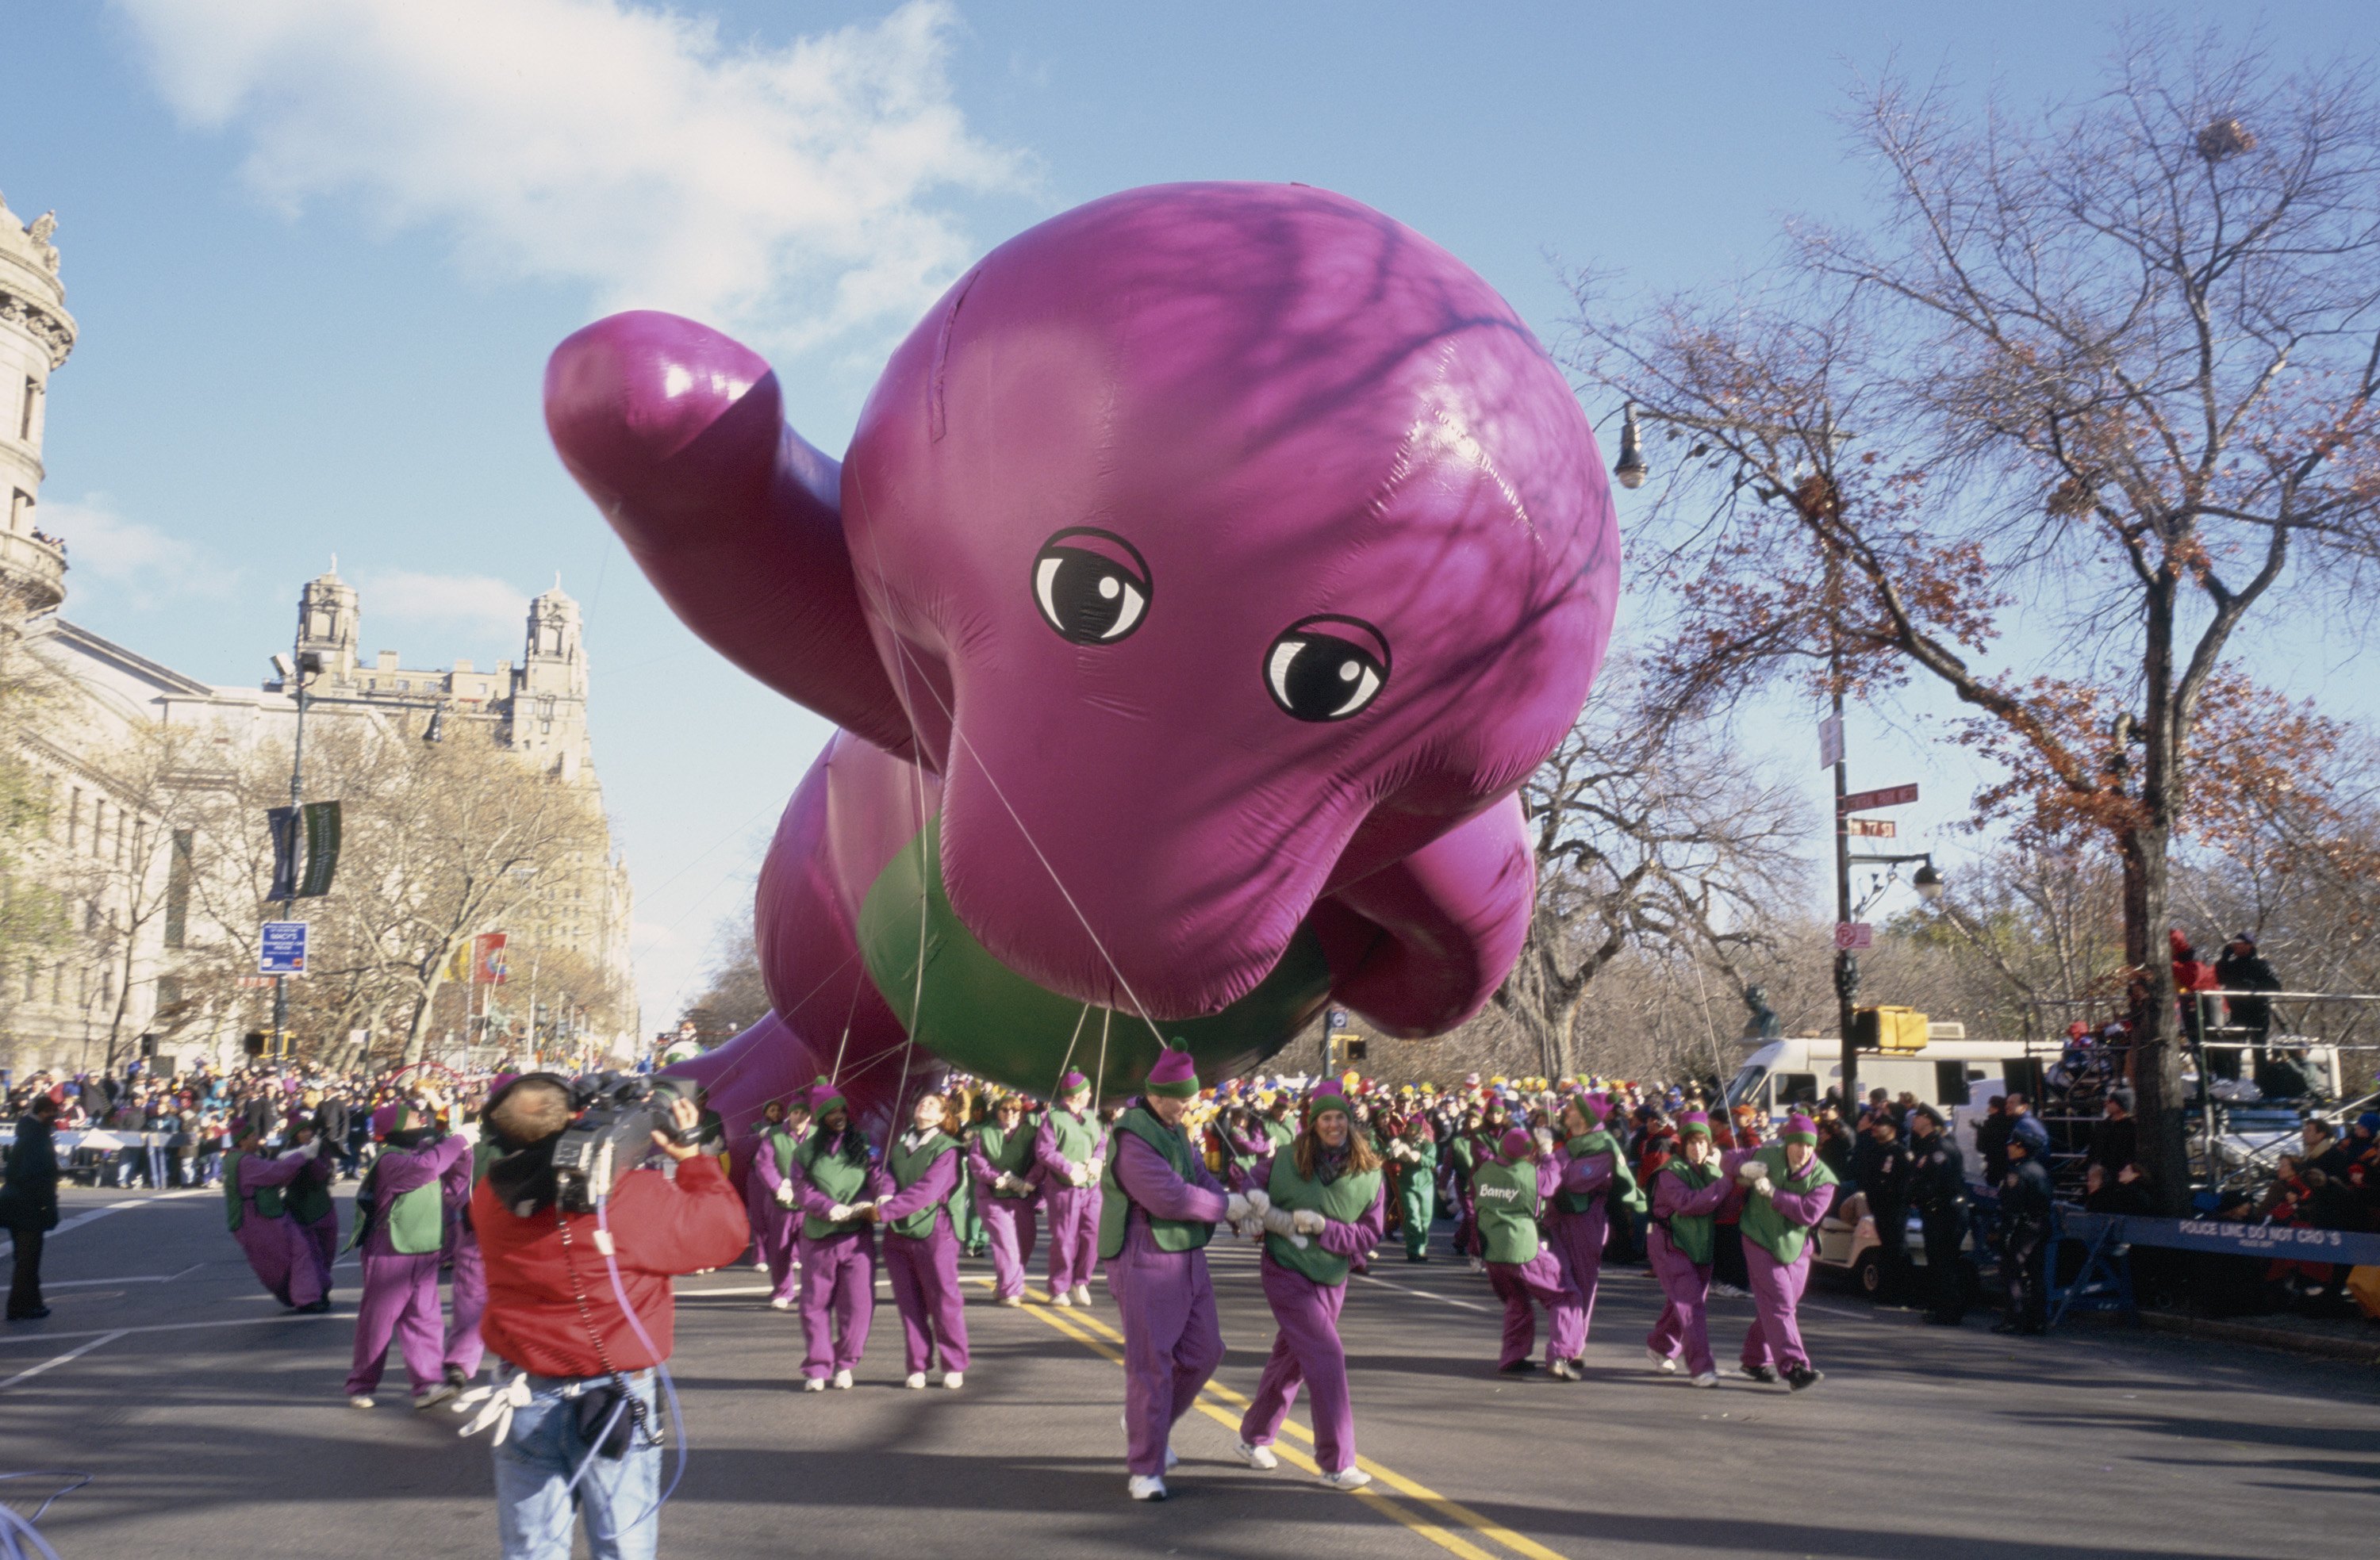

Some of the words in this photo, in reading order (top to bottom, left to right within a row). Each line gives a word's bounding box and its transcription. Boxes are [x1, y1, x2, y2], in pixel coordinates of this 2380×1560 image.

[1480, 1183, 1519, 1202] Barney
[2179, 1220, 2218, 1236] POLICE
[2221, 1223, 2246, 1238] LINE
[2248, 1225, 2267, 1240] DO
[2269, 1227, 2294, 1242] NOT
[2297, 1228, 2341, 1247] CROS
